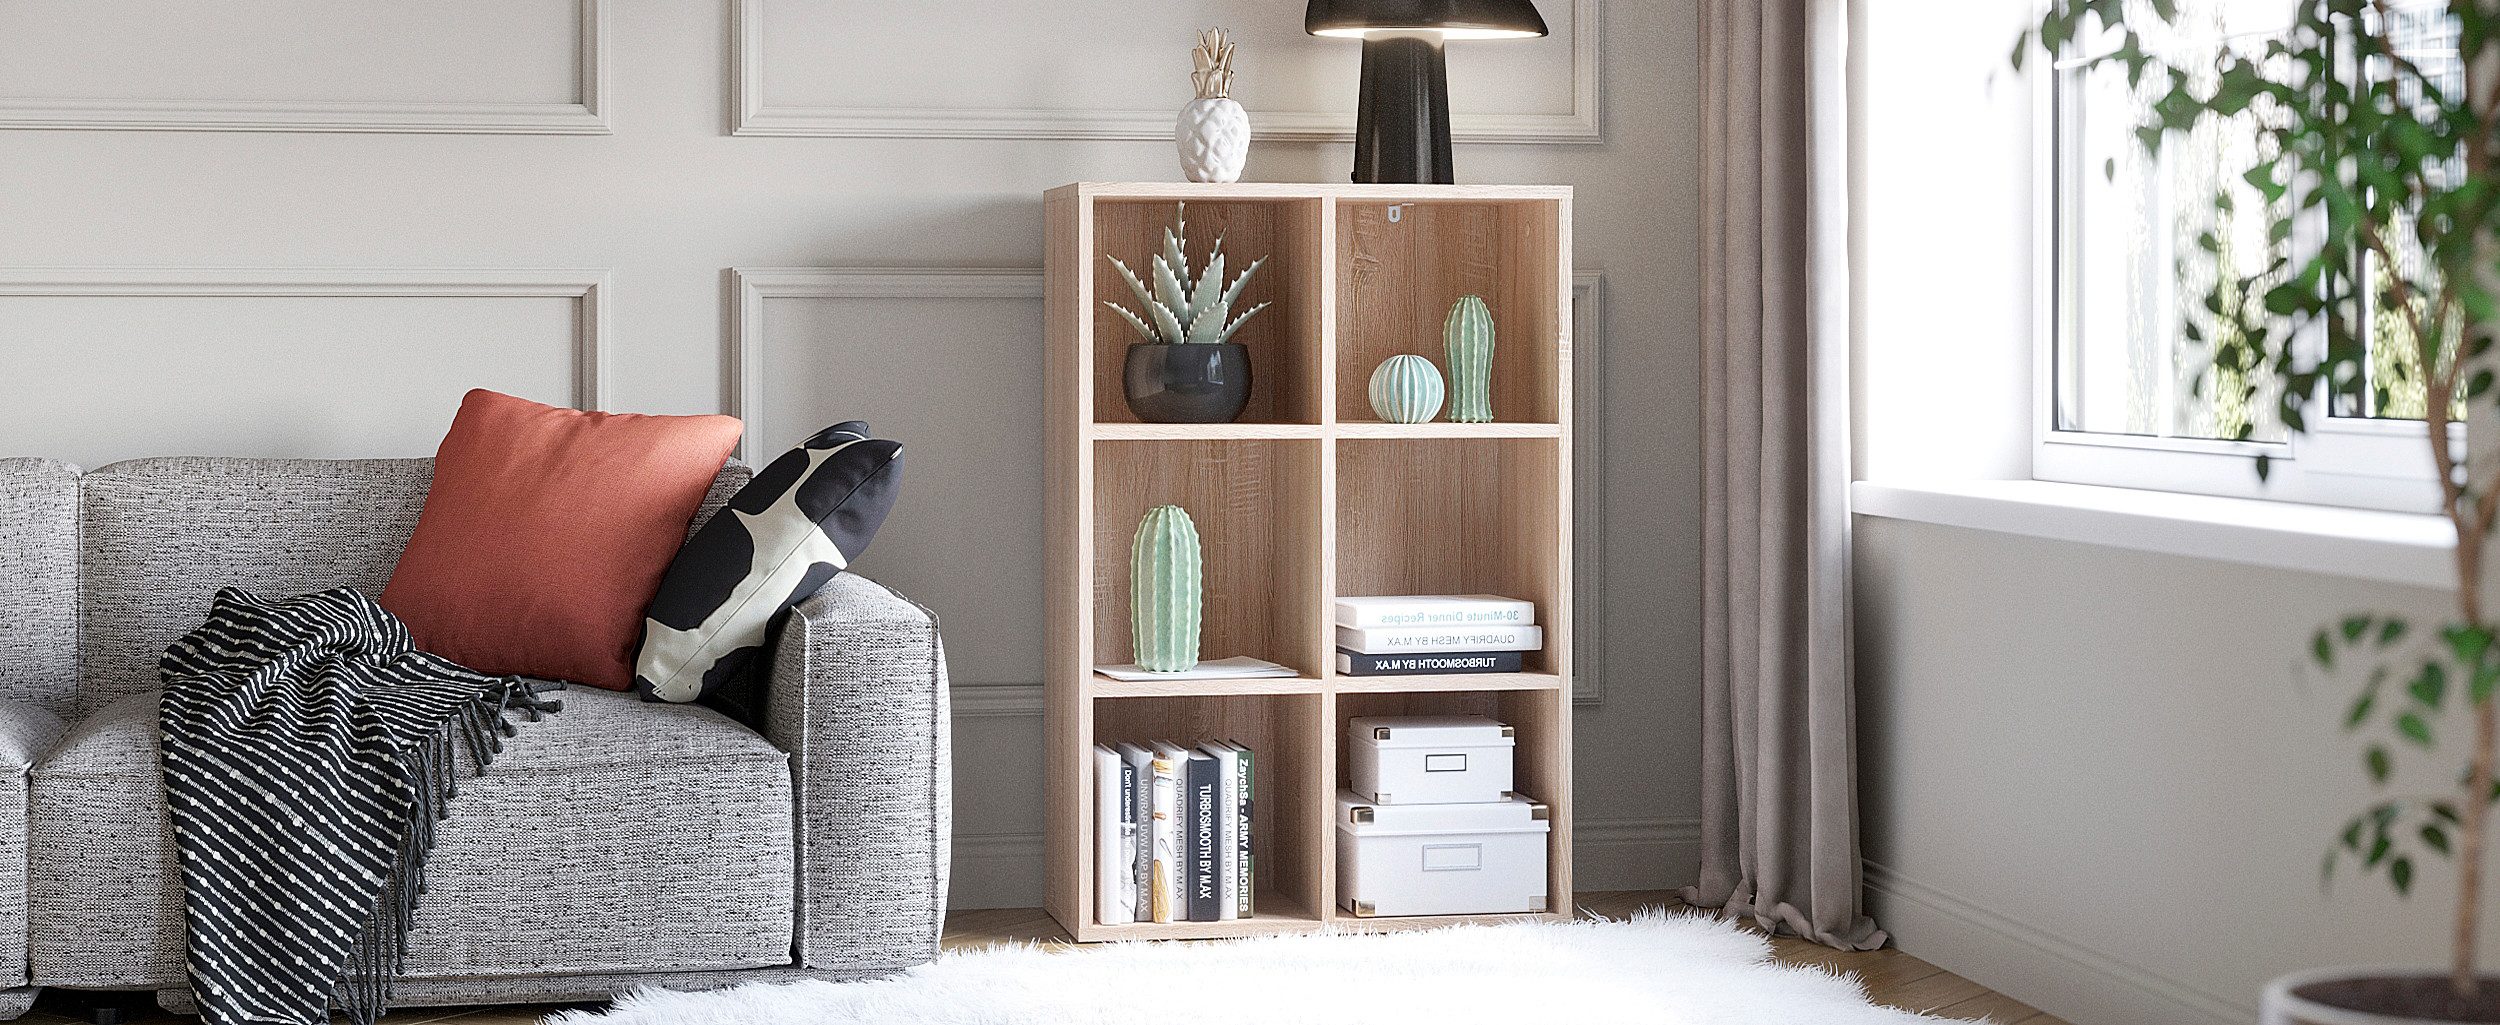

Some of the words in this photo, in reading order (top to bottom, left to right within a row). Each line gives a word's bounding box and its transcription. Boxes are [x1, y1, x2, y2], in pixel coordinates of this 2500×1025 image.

[1124, 769, 1132, 788] Don't
[1140, 779, 1148, 822] UNWRAP
[1175, 778, 1184, 828] QUADRIFY
[1224, 778, 1232, 828] QUADRIFY
[1199, 784, 1212, 859] TURBOSMOOTH
[1239, 814, 1249, 848] ARMY
[1140, 824, 1148, 847] UVW
[1175, 830, 1184, 858] MESH
[1224, 830, 1232, 858] MESH
[1140, 849, 1148, 870] MAP
[1175, 861, 1184, 873] BY
[1199, 860, 1212, 873] BY
[1224, 861, 1232, 873] BY
[1140, 872, 1148, 886] BY
[1199, 874, 1212, 899] M.AX
[1239, 850, 1249, 912] MEMORIES
[1140, 887, 1148, 912] M.AX
